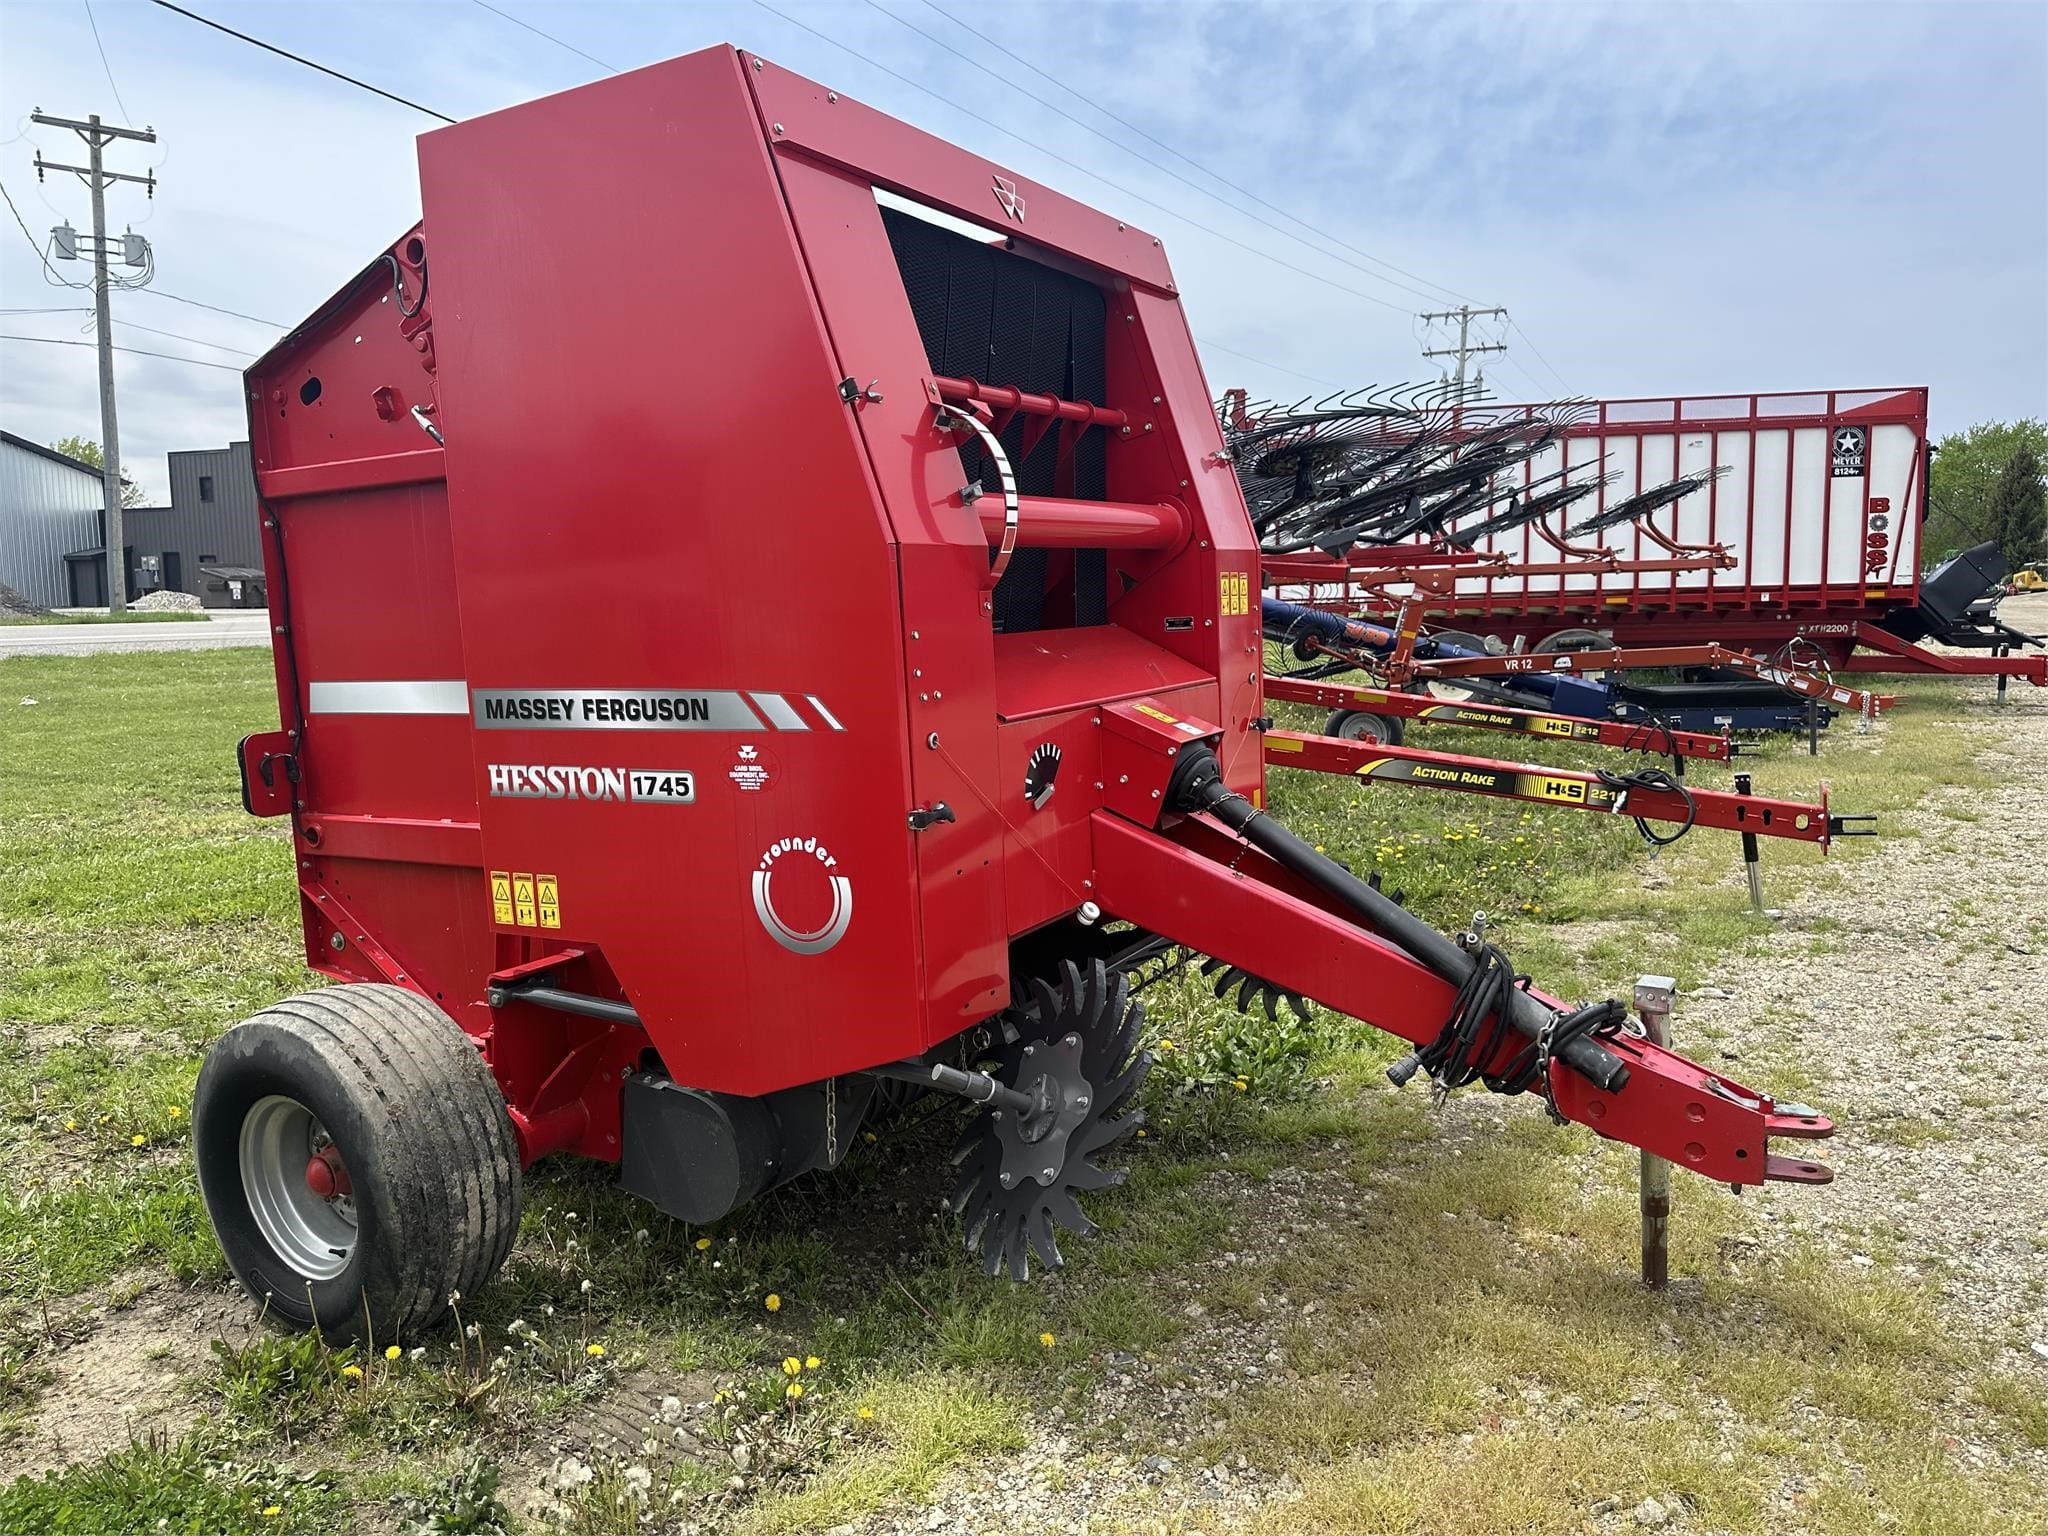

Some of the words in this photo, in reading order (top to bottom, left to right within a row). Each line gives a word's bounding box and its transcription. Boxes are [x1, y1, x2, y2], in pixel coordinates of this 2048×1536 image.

[1832, 456, 1861, 466] MEYER
[1504, 660, 1519, 670] VR
[1520, 659, 1532, 669] 12
[486, 698, 574, 721] MASSEY
[582, 698, 709, 722] FERGUSON
[1456, 710, 1488, 722] ACTION
[1489, 714, 1513, 726] RAKE
[1546, 721, 1571, 733] H&S
[487, 764, 626, 802] HESSTON
[633, 776, 690, 797] 1745
[1412, 766, 1458, 781] ACTION
[1461, 771, 1496, 786] RAKE
[1545, 781, 1583, 799] H&S
[1591, 789, 1621, 801] 221
[762, 836, 838, 870] rounder
